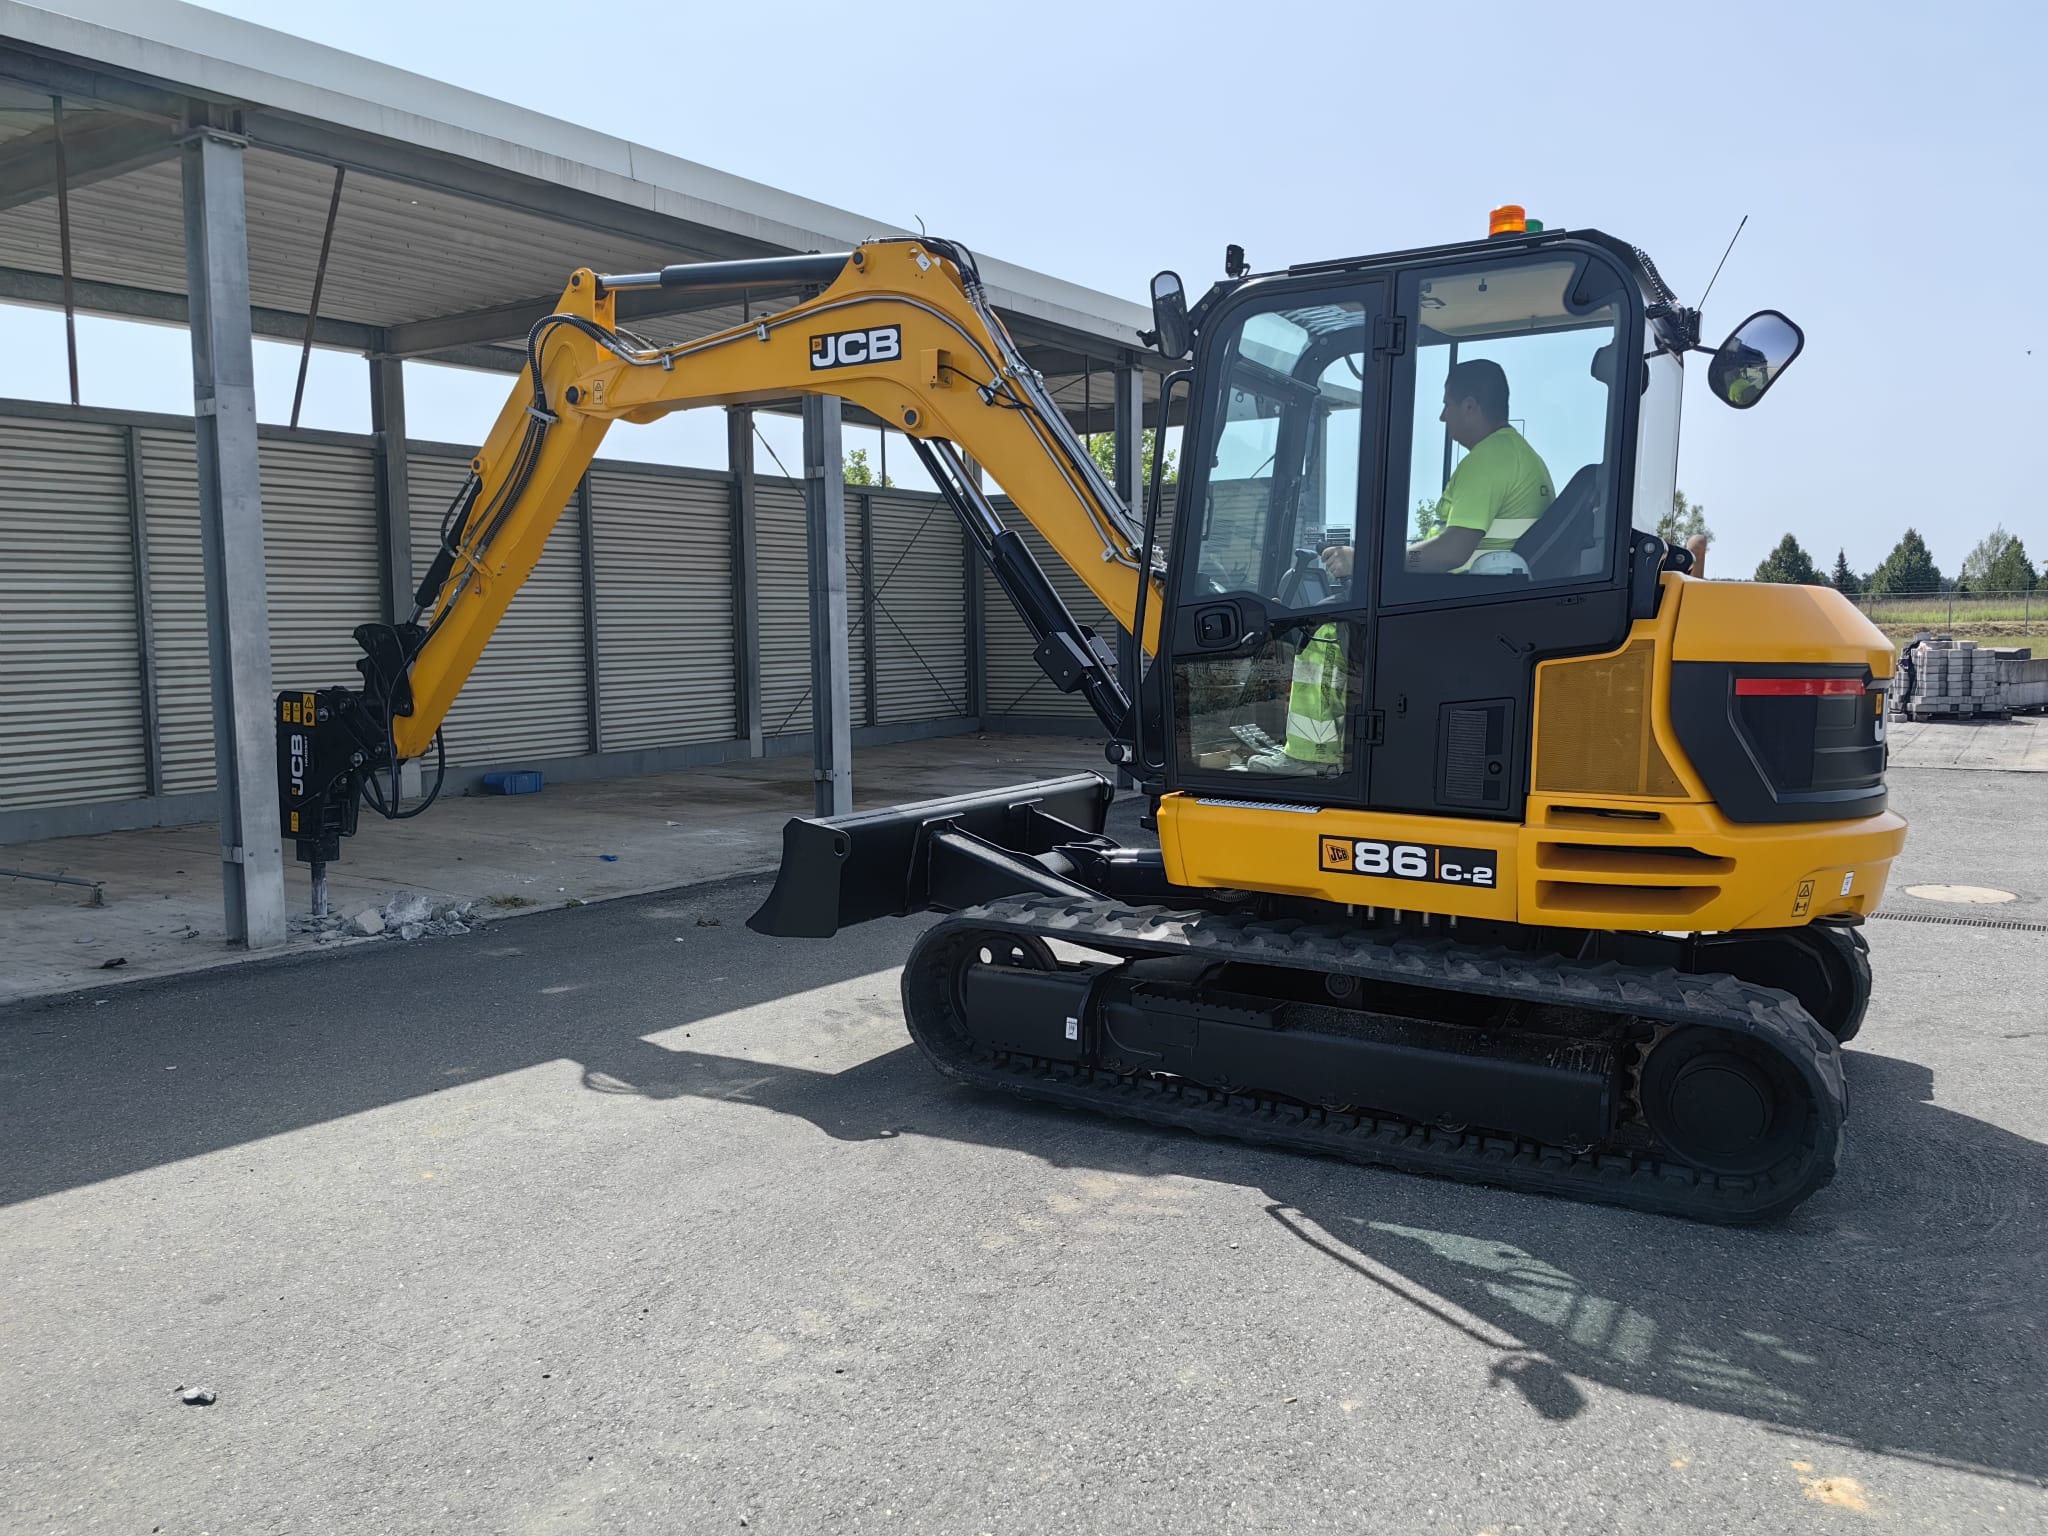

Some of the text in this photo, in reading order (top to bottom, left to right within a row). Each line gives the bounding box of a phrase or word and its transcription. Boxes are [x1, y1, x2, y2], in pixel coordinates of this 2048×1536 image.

[812, 328, 899, 367] JCB
[291, 734, 304, 796] JCB
[1329, 841, 1494, 885] JCB 86 C-2
